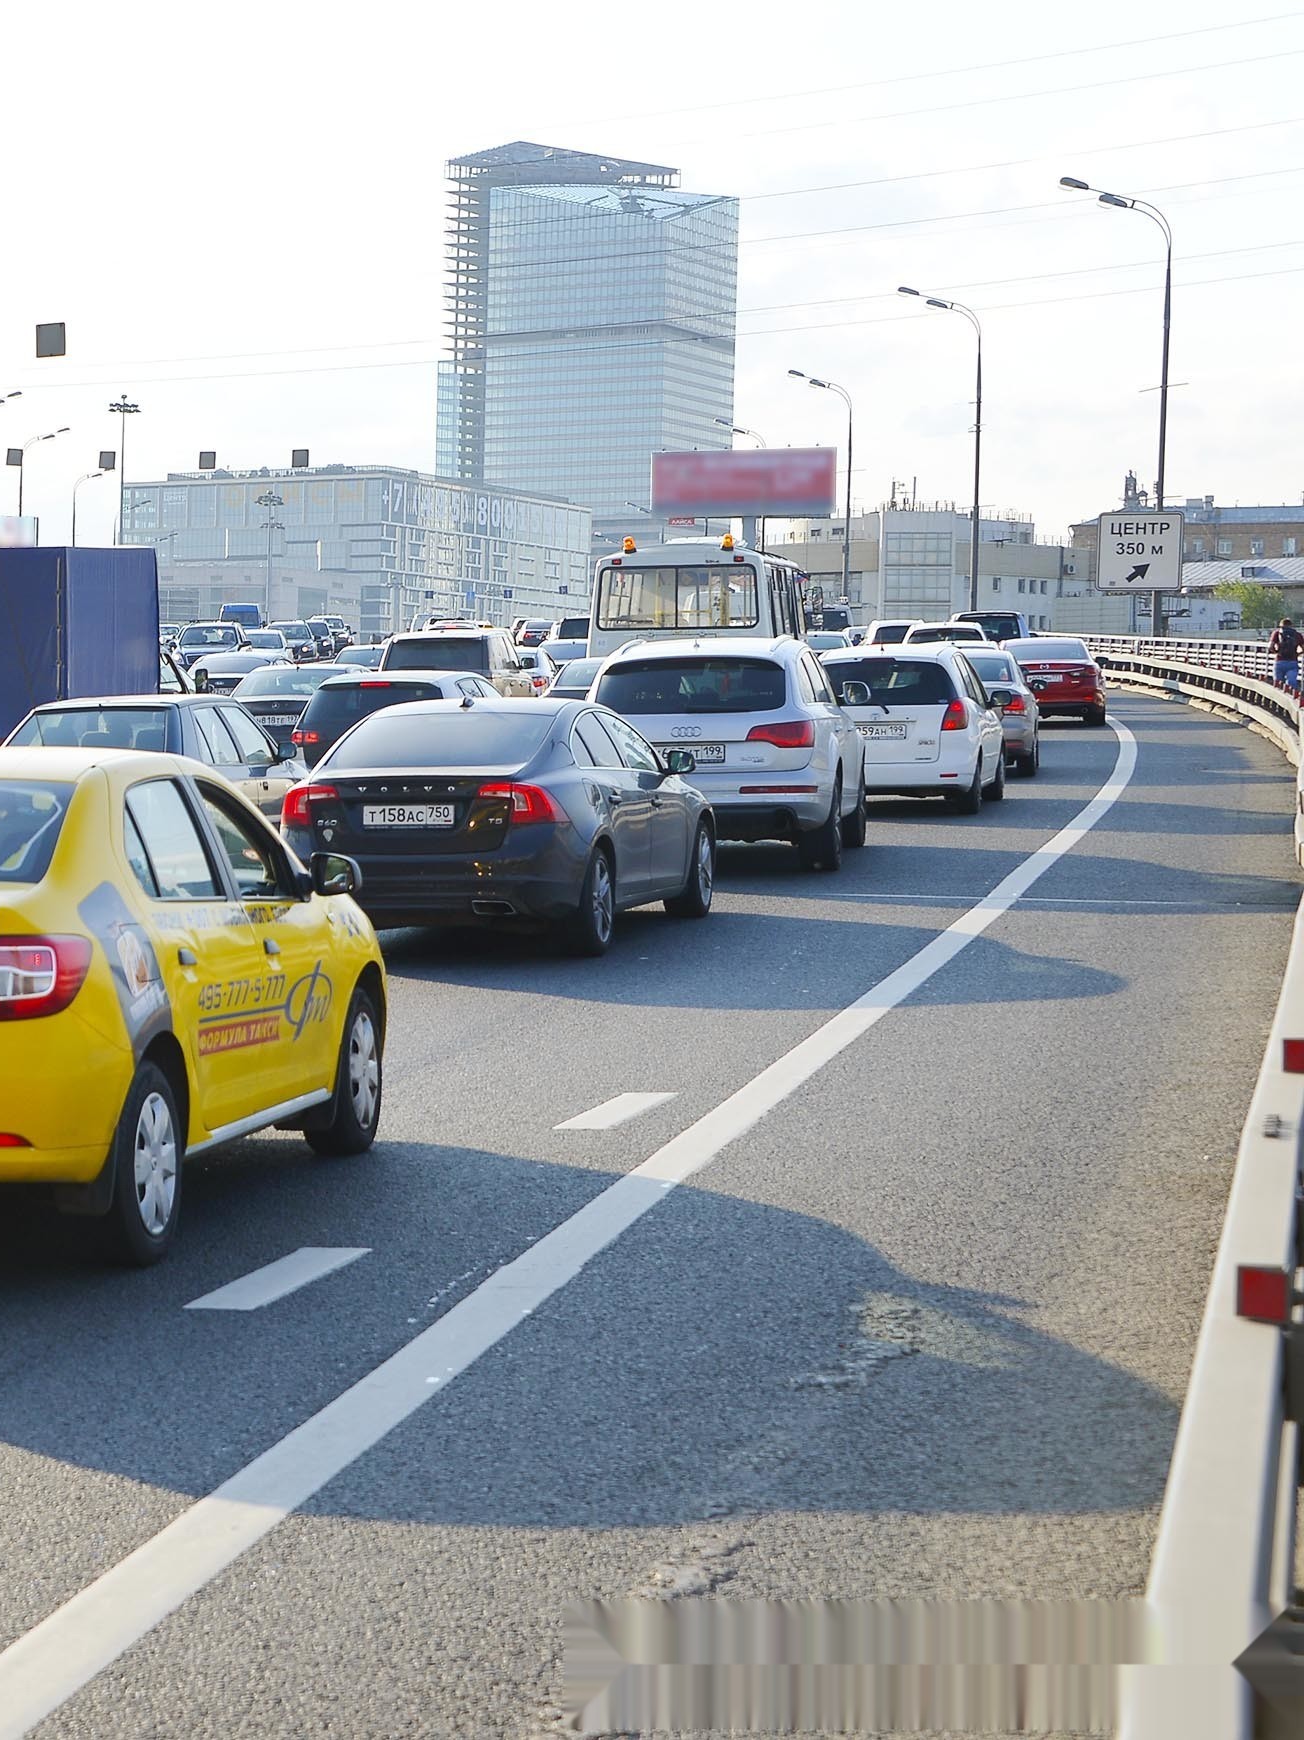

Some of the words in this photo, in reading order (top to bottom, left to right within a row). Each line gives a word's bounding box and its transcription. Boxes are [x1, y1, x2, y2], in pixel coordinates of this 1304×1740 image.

[1110, 522, 1171, 537] ЦЕНТР
[1116, 542, 1145, 555] 350
[357, 785, 456, 793] VOLVO
[428, 806, 450, 818] 750
[199, 1024, 247, 1051] ФОРМУЛА
[249, 1019, 280, 1041] ТАКСИ
